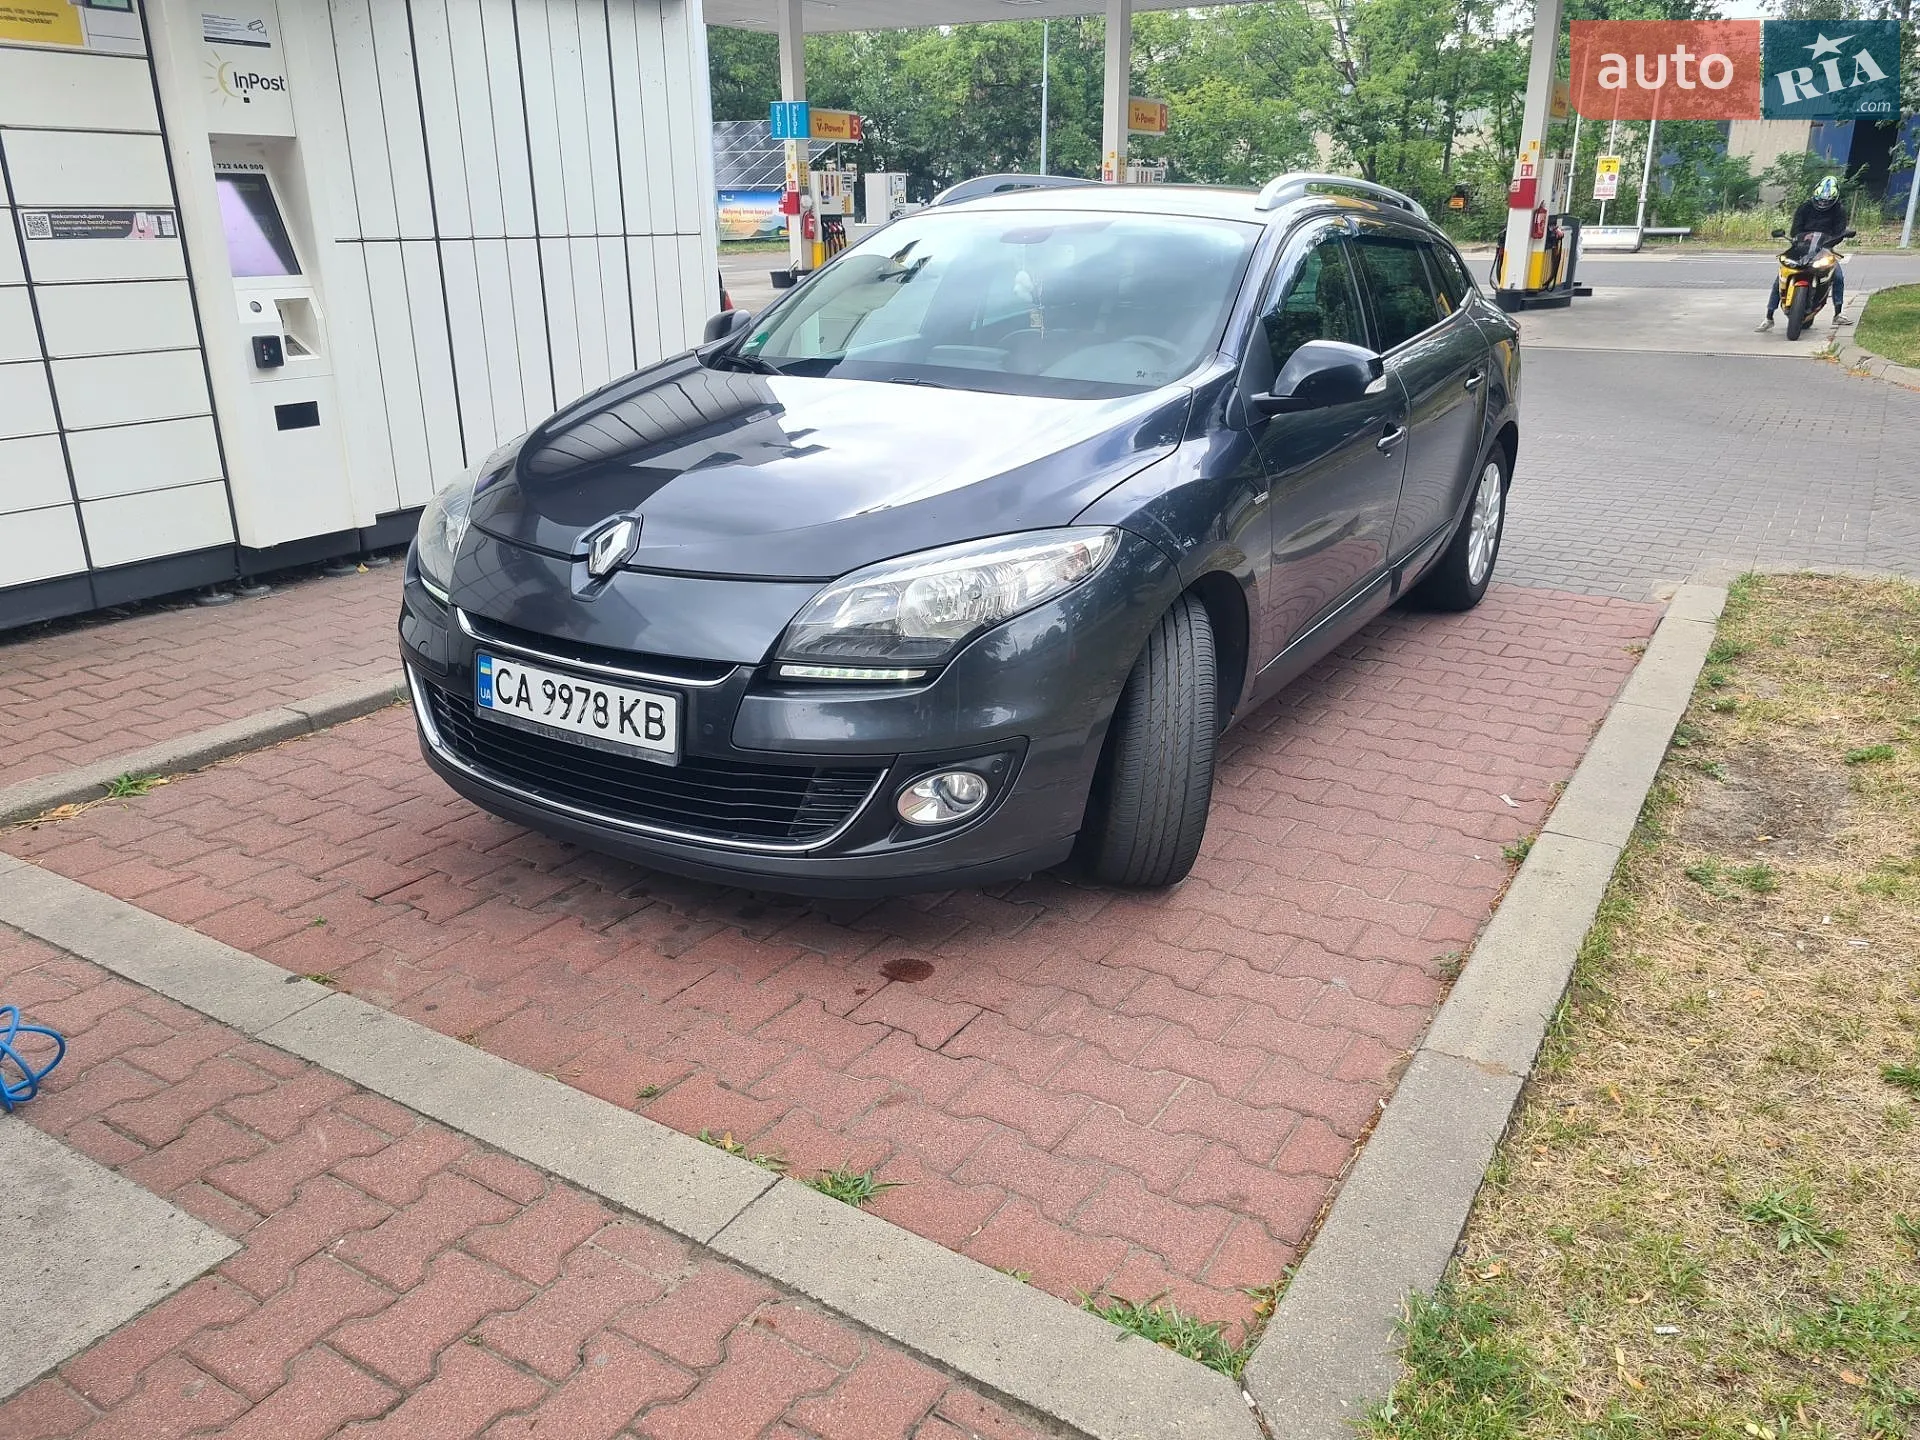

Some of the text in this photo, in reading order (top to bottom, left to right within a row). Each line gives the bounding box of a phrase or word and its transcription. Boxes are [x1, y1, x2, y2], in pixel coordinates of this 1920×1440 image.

[233, 71, 286, 92] InPost
[816, 119, 859, 136] V-Power 5
[480, 686, 492, 700] UA
[495, 667, 667, 742] CA 9978 KB
